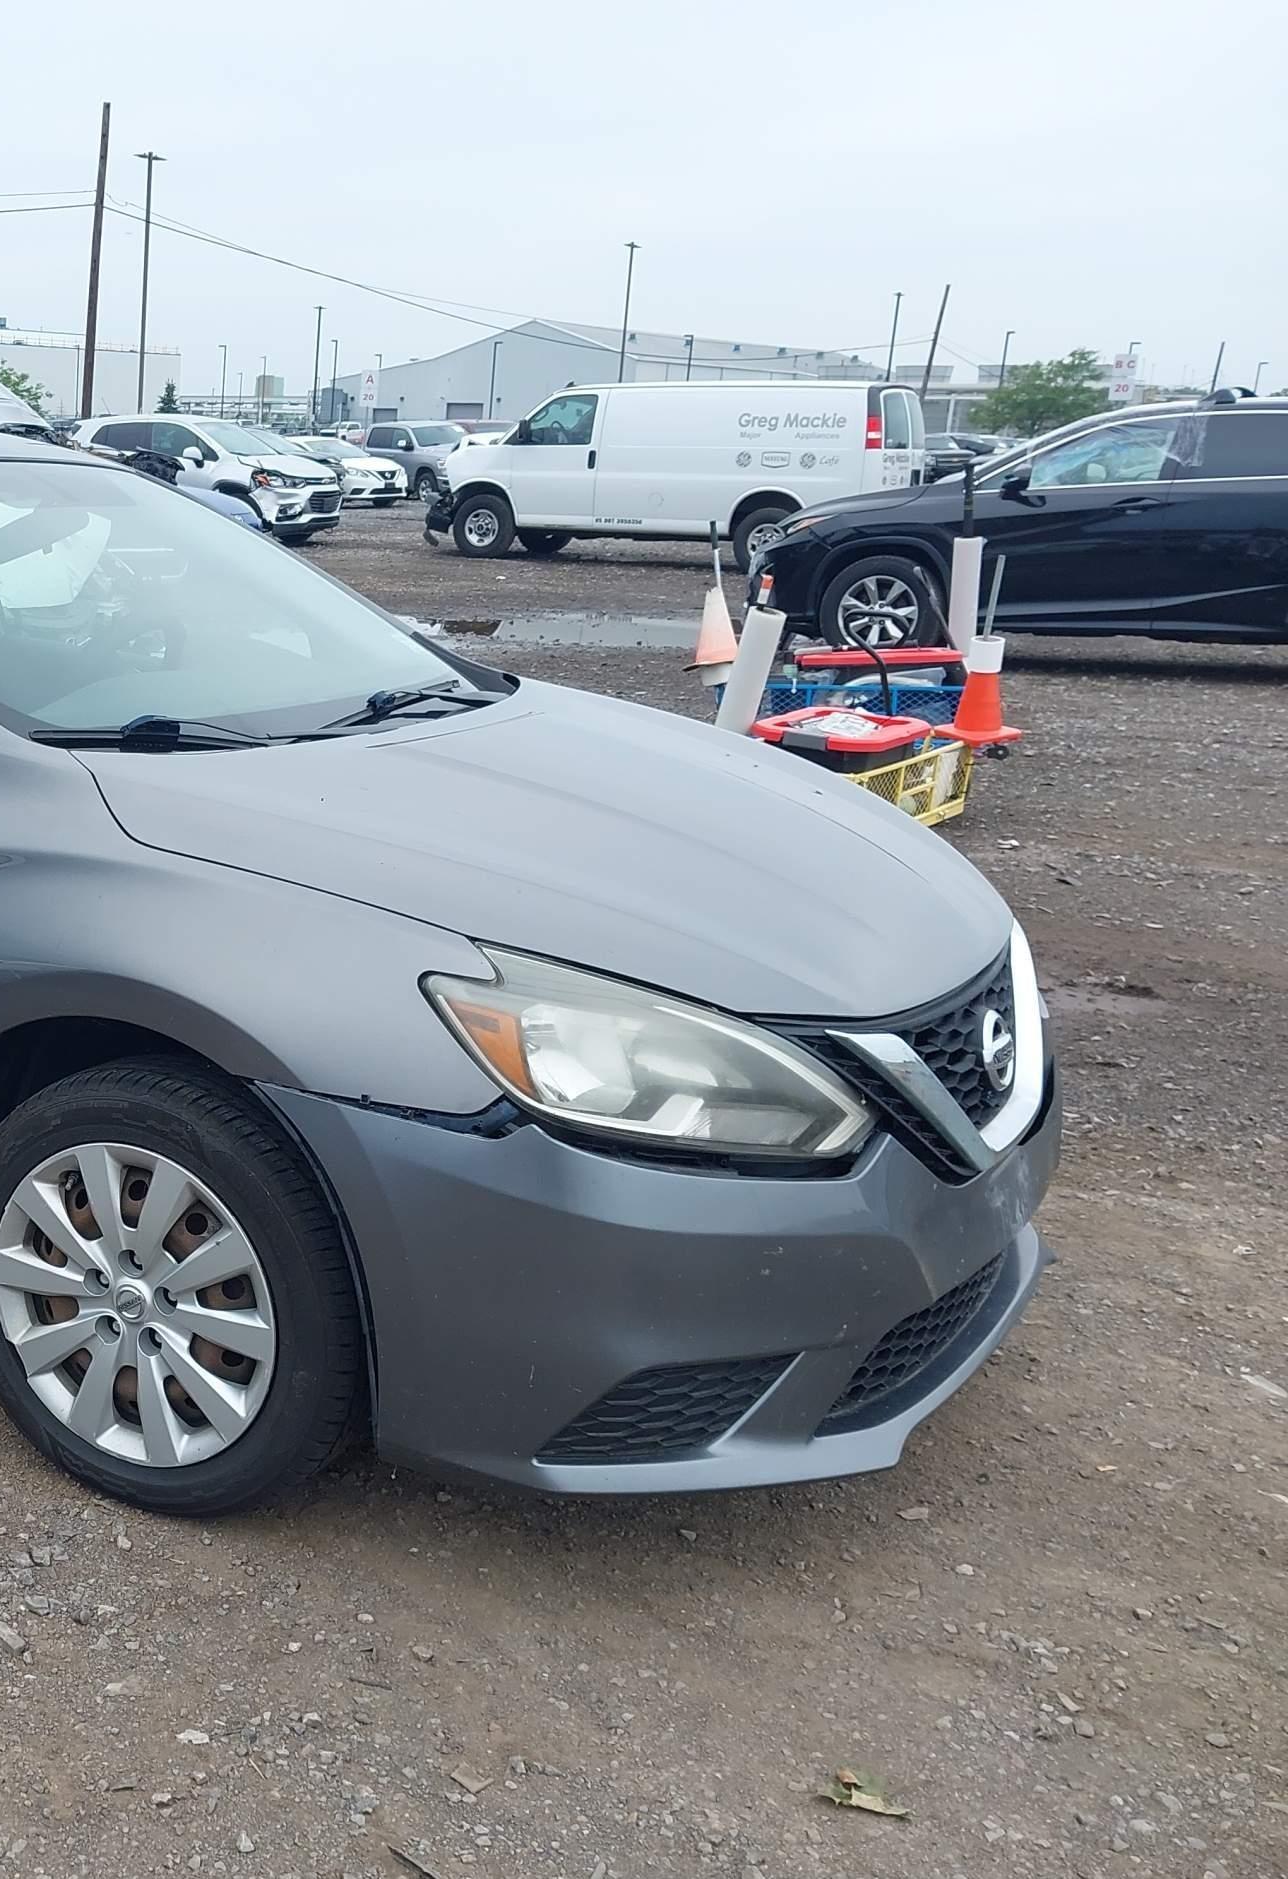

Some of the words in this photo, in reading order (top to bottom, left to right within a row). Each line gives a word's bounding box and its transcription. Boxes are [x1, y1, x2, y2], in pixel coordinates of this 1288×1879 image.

[1115, 360, 1123, 369] B
[1127, 360, 1136, 369] C
[365, 375, 374, 384] A
[1114, 384, 1129, 392] 20
[738, 412, 780, 432] Greg
[783, 412, 847, 429] Mackie
[794, 432, 840, 440] Appliances
